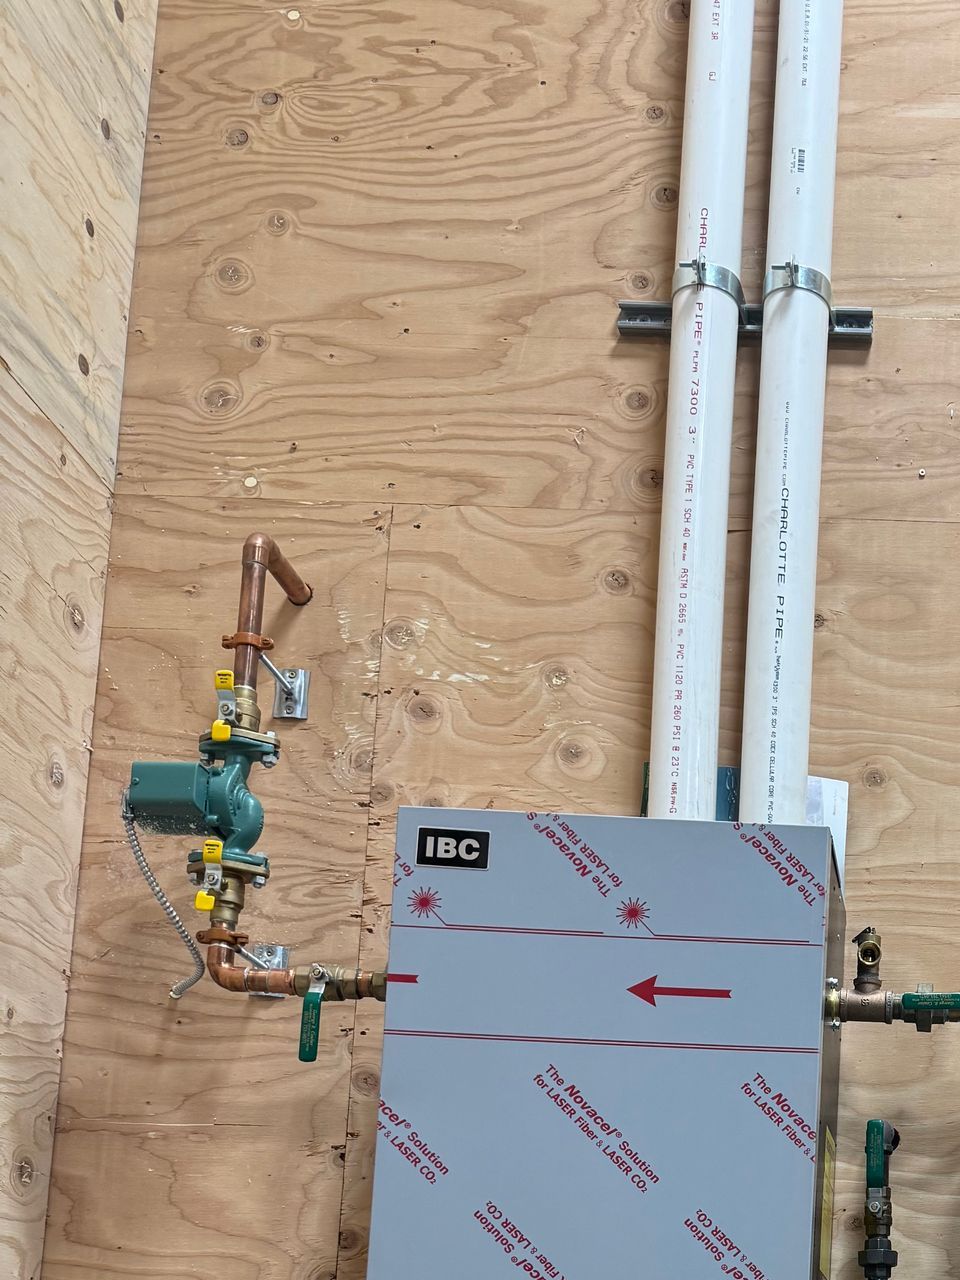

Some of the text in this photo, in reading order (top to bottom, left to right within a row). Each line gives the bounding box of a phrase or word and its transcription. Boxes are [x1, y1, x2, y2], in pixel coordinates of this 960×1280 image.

[697, 207, 709, 292] CHARLE
[690, 378, 699, 415] 7300
[685, 474, 693, 493] TYPE
[684, 508, 692, 523] SCH
[683, 528, 690, 537] 40
[778, 488, 789, 584] CHARLOTTE
[679, 568, 688, 588] ASTM
[678, 603, 687, 623] 2665
[775, 596, 784, 639] PIPE
[675, 666, 683, 684] 1120
[673, 725, 681, 740] PSI
[671, 756, 679, 777] 23°C
[425, 836, 480, 861] IBC
[552, 814, 623, 887] for LASER Fiber &
[763, 831, 787, 855] Fiber
[398, 862, 414, 877] for
[785, 852, 815, 883] LASER
[592, 875, 611, 898] The
[797, 884, 816, 907] The
[740, 1082, 811, 1156] for LASER Fiber &
[752, 1072, 817, 1140] The Novace
[532, 1074, 549, 1089] for
[546, 1087, 577, 1119] LASER
[573, 1116, 599, 1141] Fiber
[595, 1139, 604, 1148] &
[601, 1145, 633, 1176] LASER
[545, 1063, 565, 1086] The
[618, 1140, 660, 1184] Solution
[383, 1130, 392, 1139] &
[390, 1135, 421, 1167] LASER
[407, 1131, 449, 1175] Solution
[473, 1210, 515, 1254] Solution
[500, 1217, 532, 1250] LASER
[683, 1218, 725, 1262] Solution
[711, 1226, 742, 1258] LASER
[530, 1246, 538, 1255] &
[739, 1254, 748, 1263] &
[535, 1254, 560, 1278] Fiber
